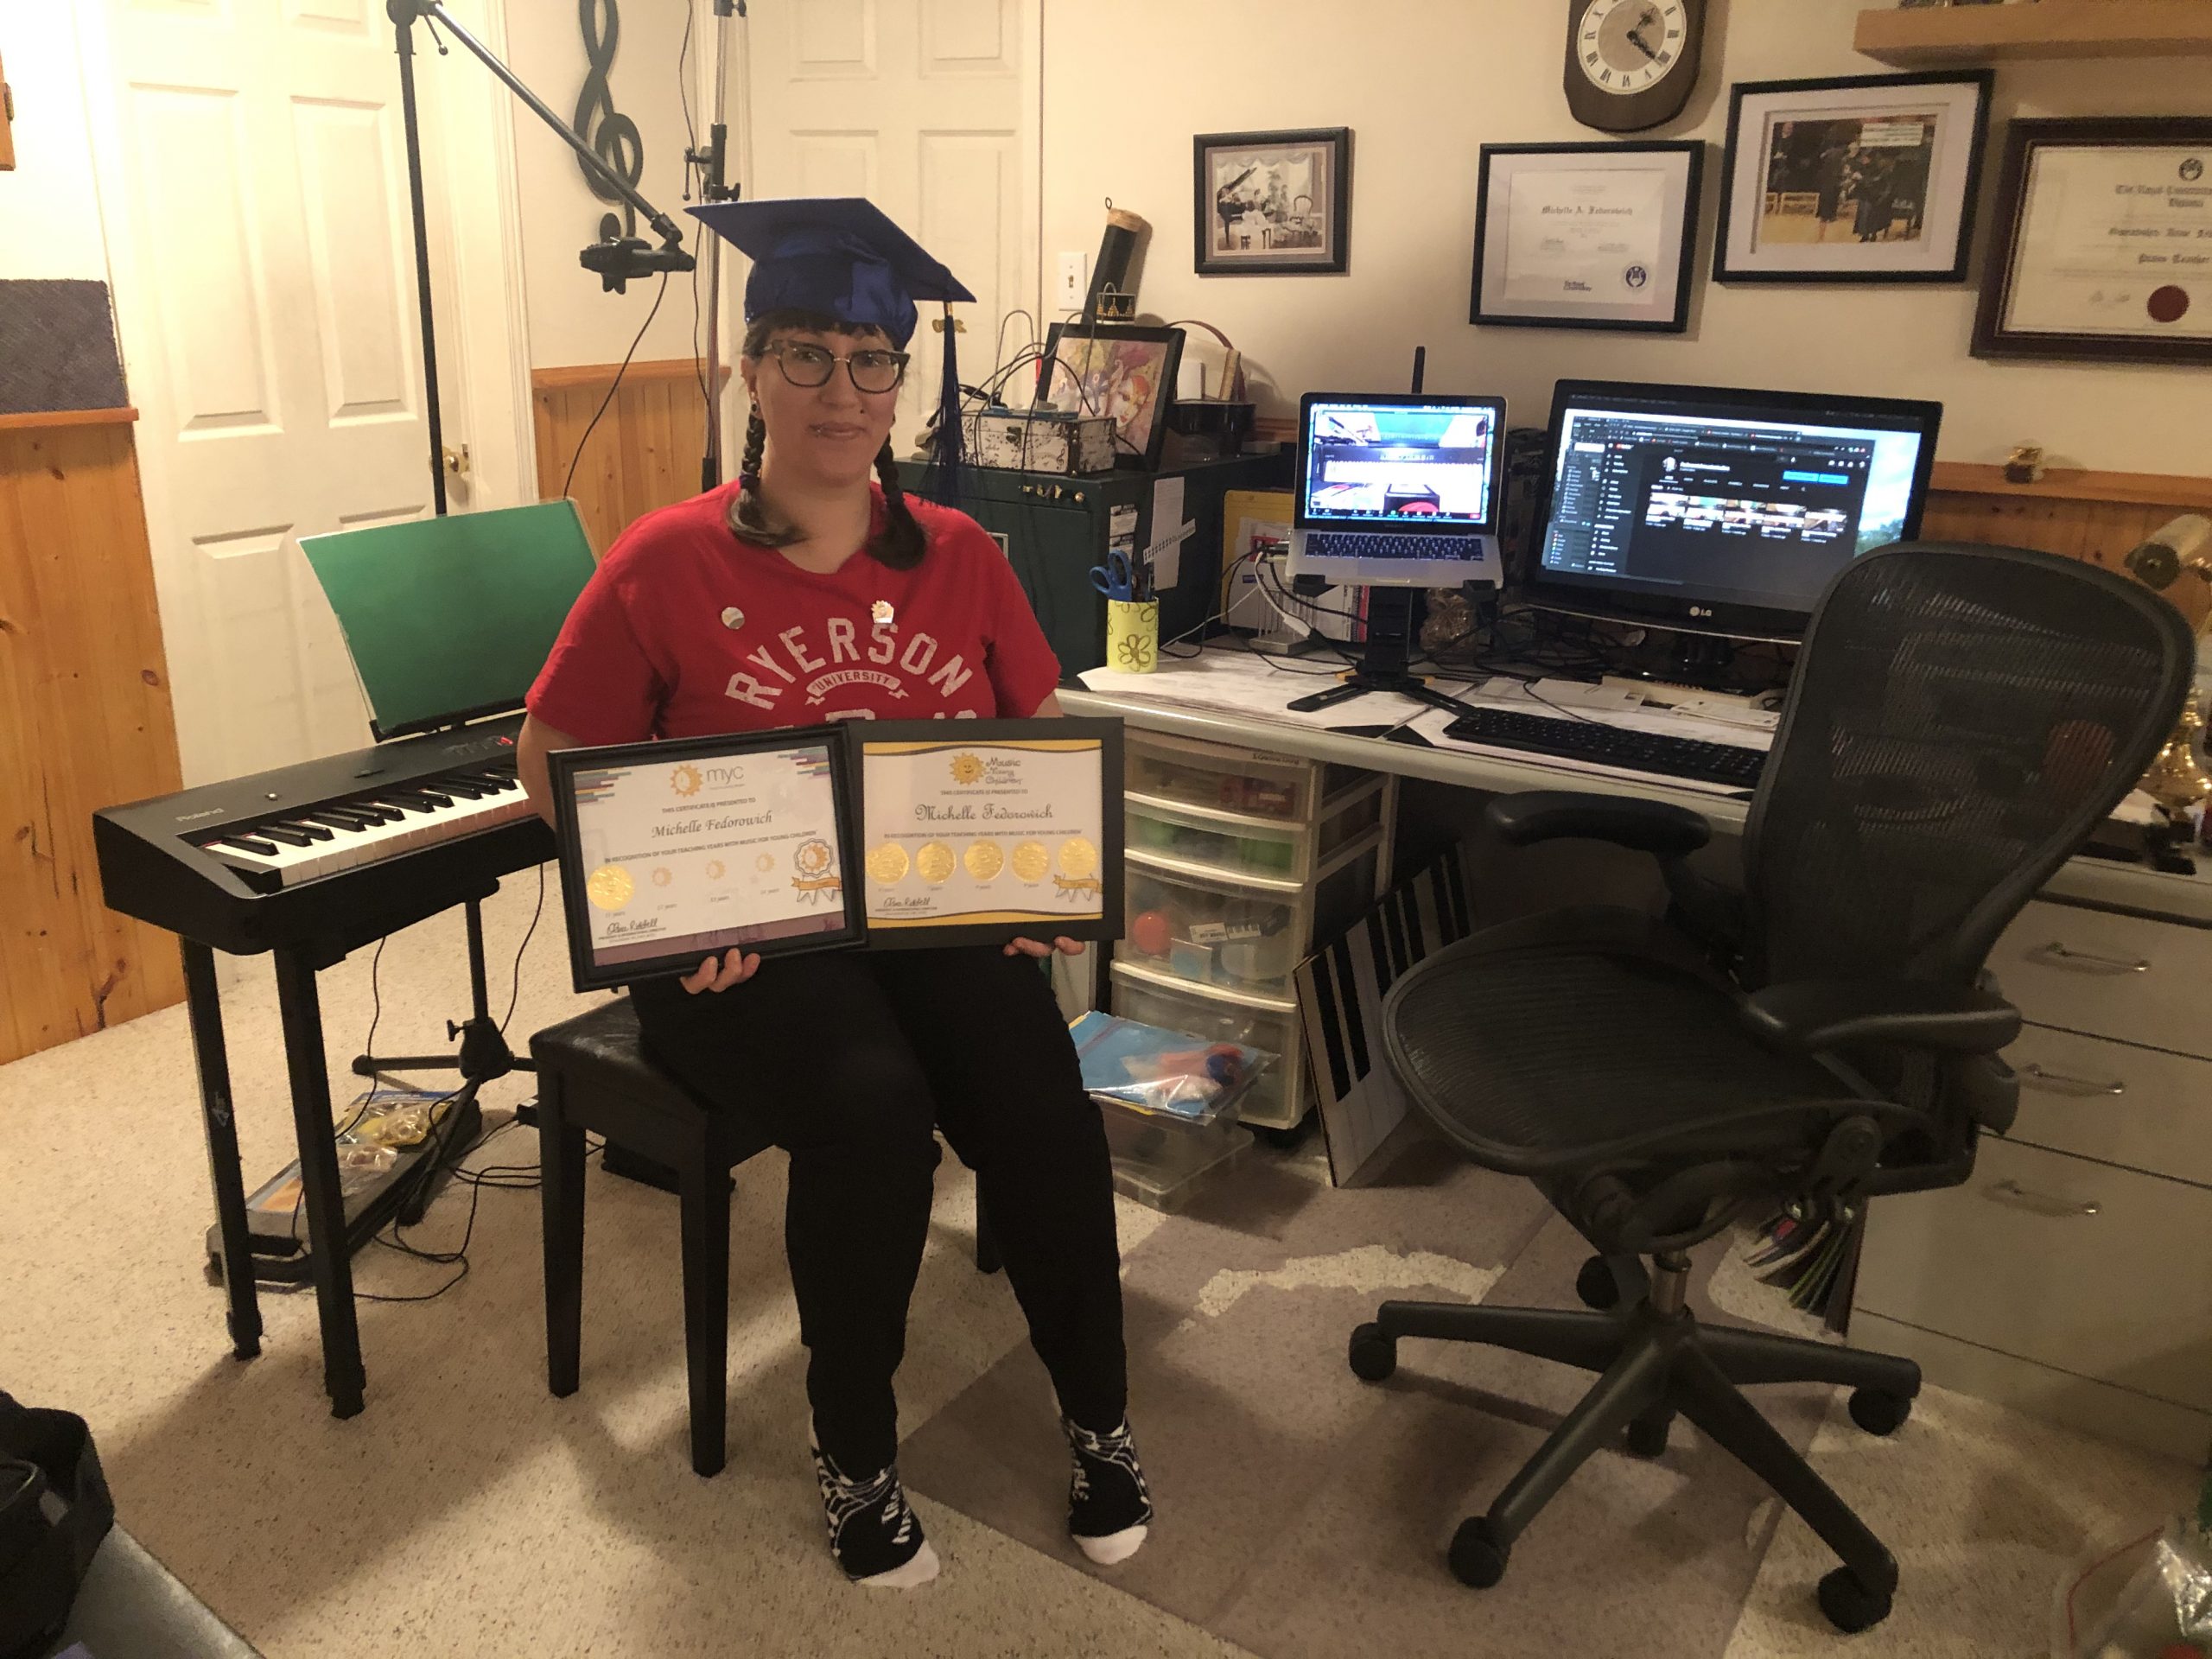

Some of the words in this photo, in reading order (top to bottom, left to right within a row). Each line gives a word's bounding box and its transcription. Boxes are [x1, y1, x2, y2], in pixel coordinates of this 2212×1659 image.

[1700, 608, 1713, 617] LG
[724, 617, 974, 710] RYERSON
[815, 670, 891, 692] UNIVERSITY
[707, 766, 745, 785] myc
[915, 803, 977, 822] Michelle
[982, 803, 1054, 821] Fedorowich
[652, 820, 702, 838] Michelle
[706, 810, 772, 830] Fedorowich
